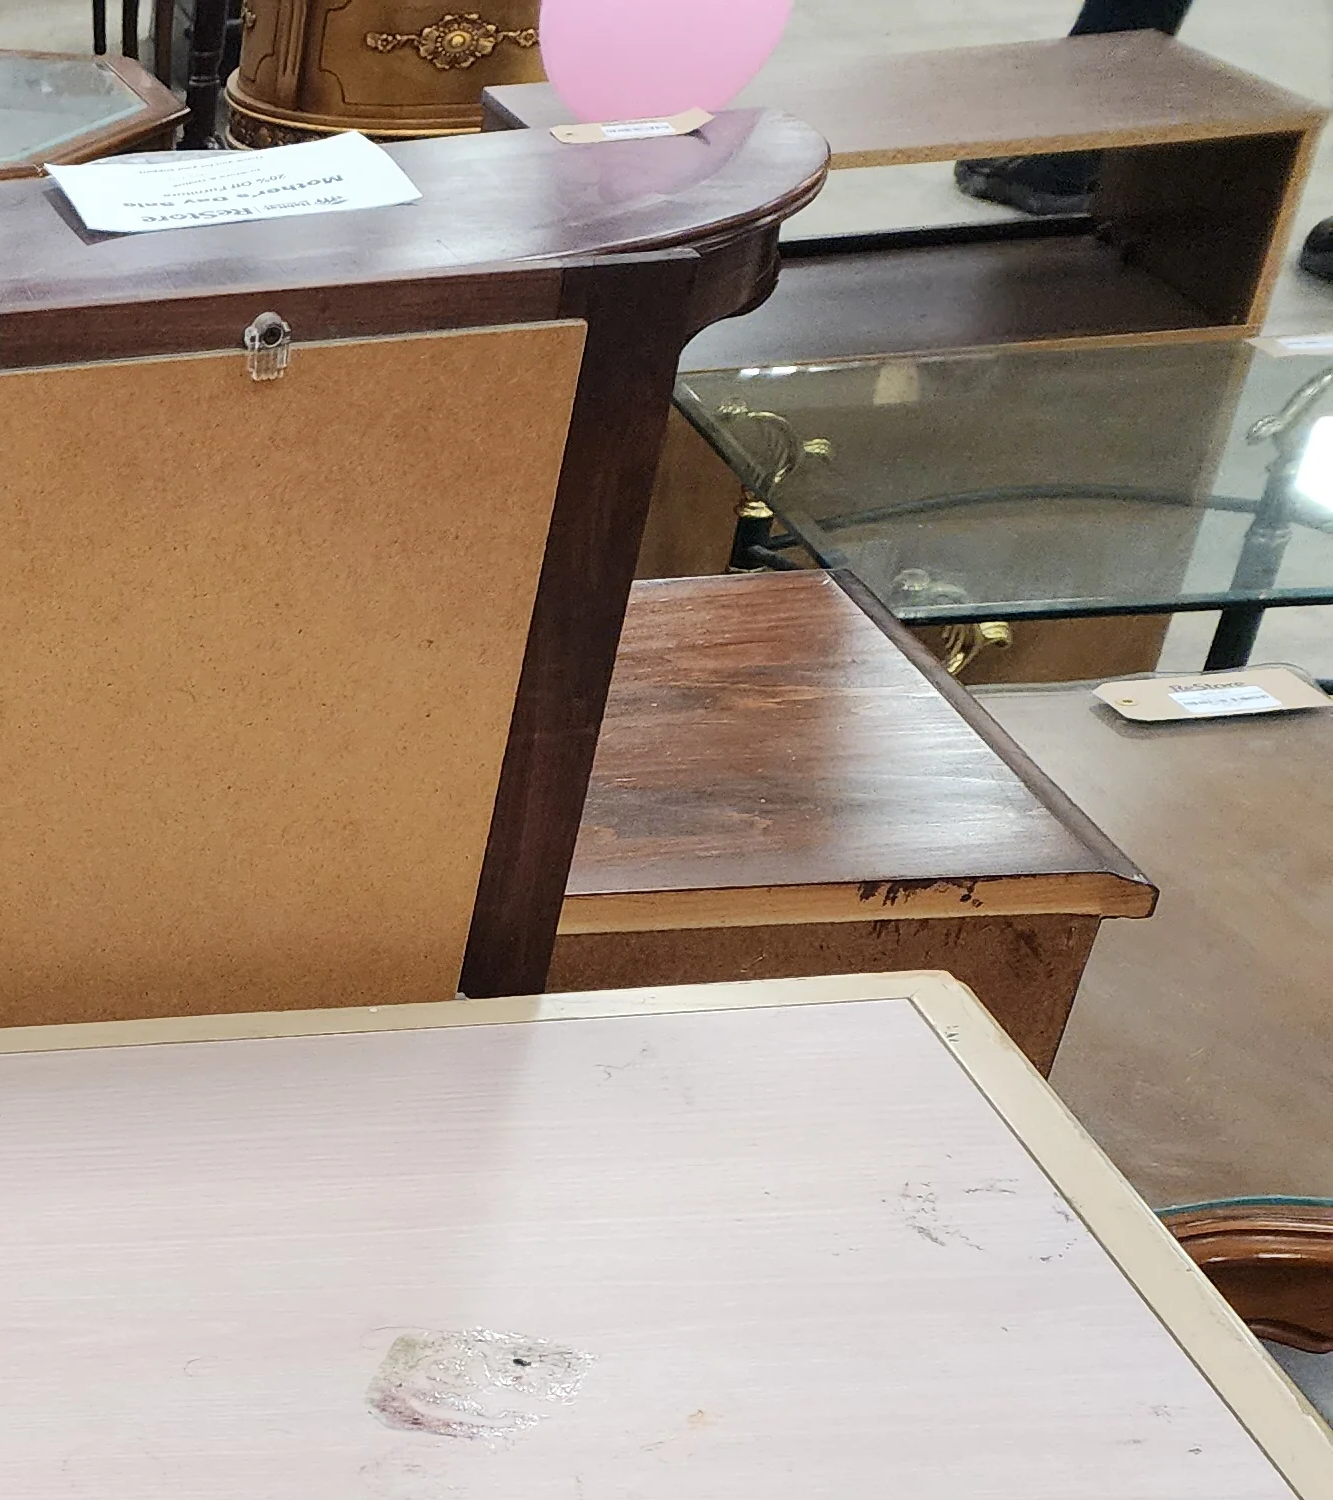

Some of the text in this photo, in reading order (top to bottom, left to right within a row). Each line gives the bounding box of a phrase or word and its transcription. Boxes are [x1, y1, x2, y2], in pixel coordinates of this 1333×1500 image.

[236, 174, 344, 199] Mother's
[183, 196, 228, 204] Day
[141, 207, 254, 223] ReStore
